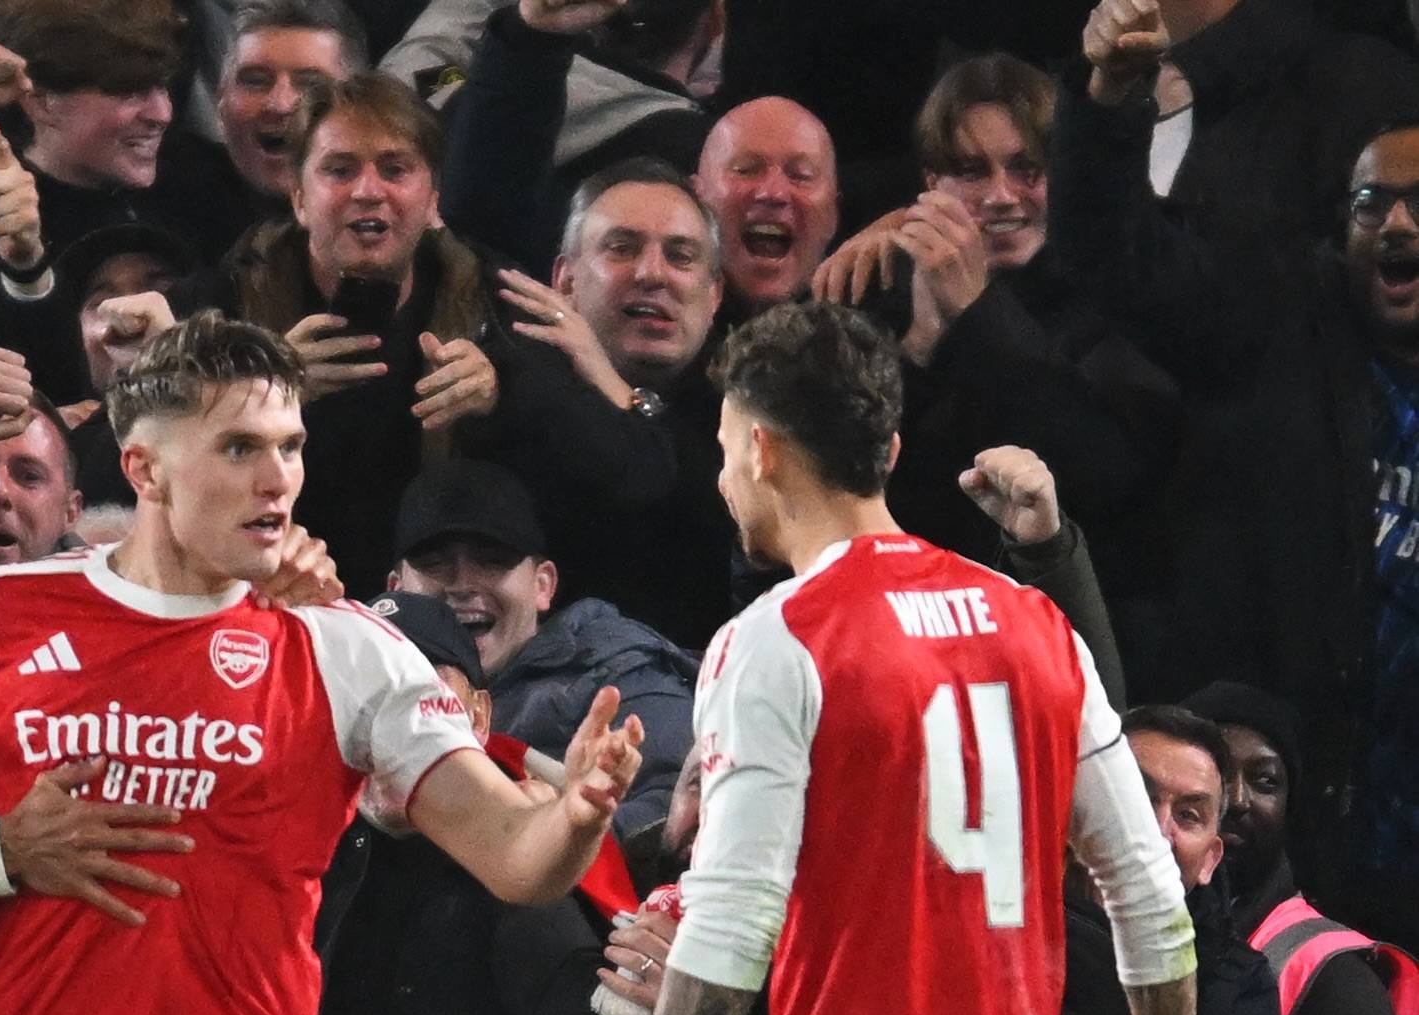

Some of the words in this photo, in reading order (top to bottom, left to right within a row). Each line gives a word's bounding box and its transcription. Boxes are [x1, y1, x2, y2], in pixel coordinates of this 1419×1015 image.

[884, 587, 998, 637] WHITE
[14, 701, 265, 765] Emirates
[101, 760, 217, 811] BETTER
[922, 681, 1025, 928] 4
